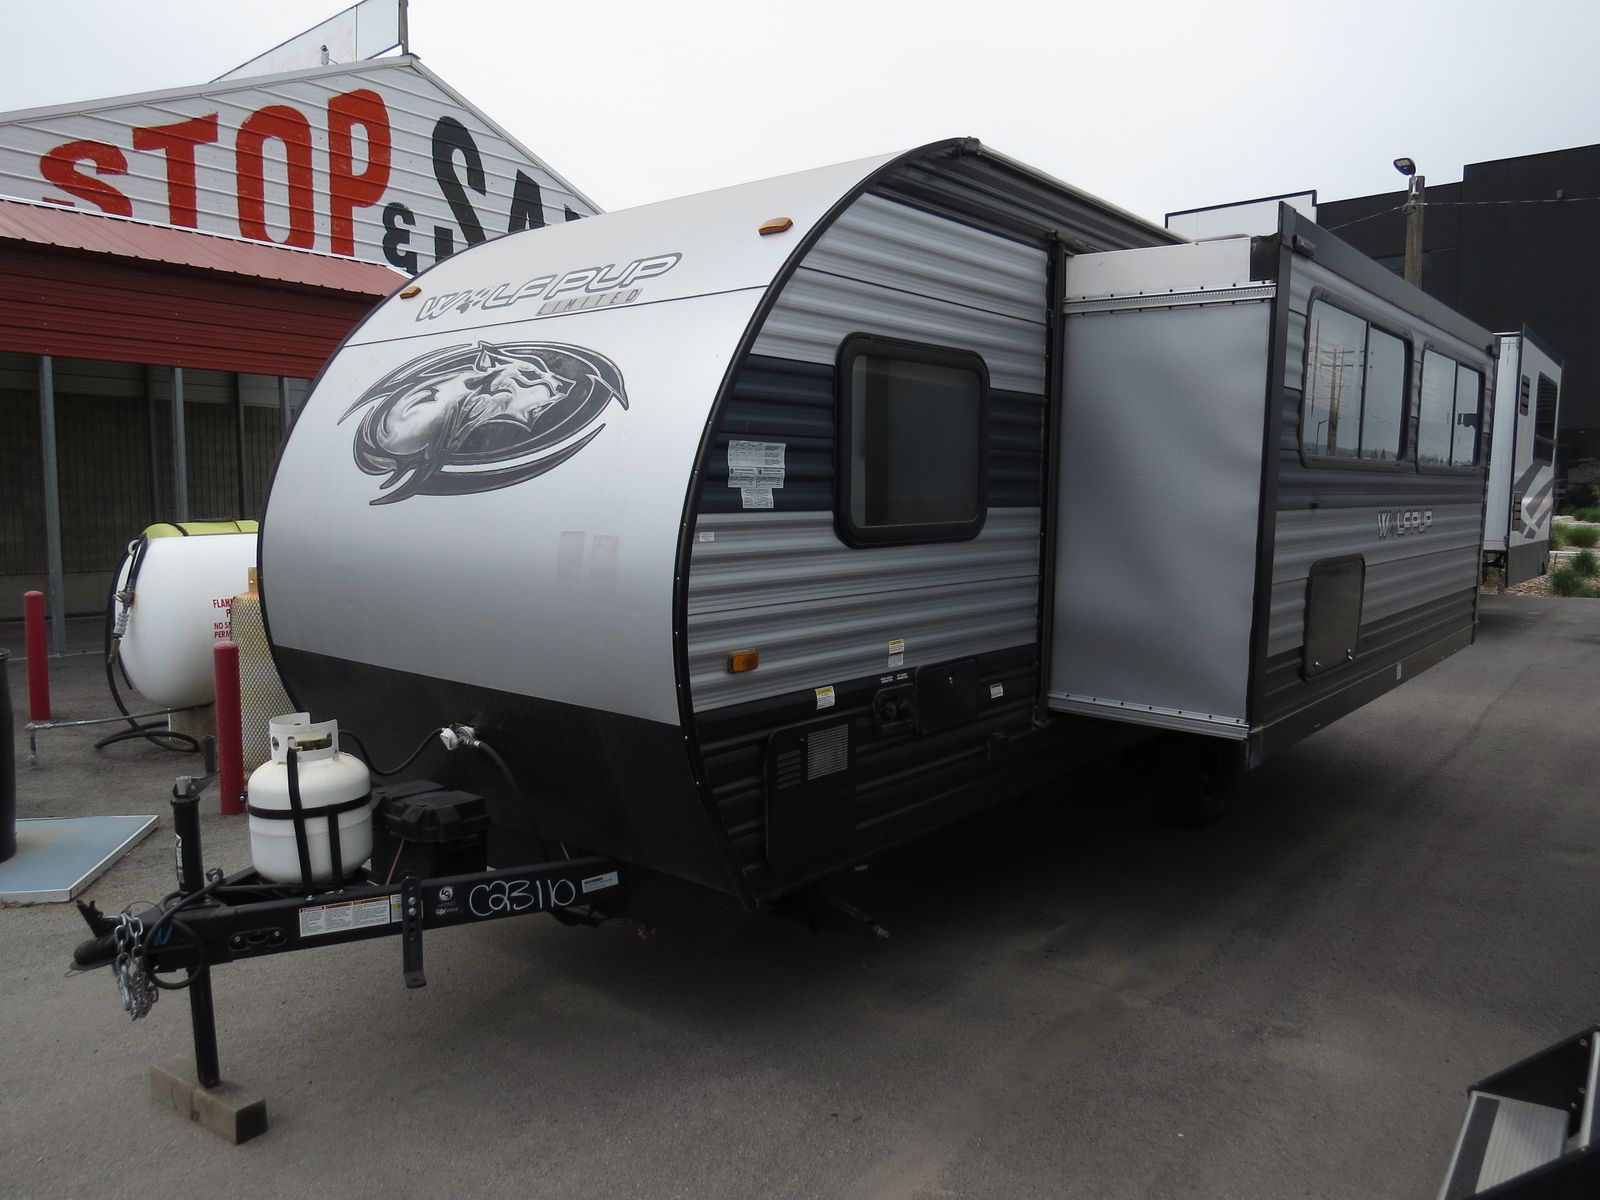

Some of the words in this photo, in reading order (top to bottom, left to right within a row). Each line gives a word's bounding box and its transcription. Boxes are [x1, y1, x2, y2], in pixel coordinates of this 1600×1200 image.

[39, 88, 392, 257] STOP
[382, 202, 418, 275] &
[536, 288, 643, 316] LIMITED
